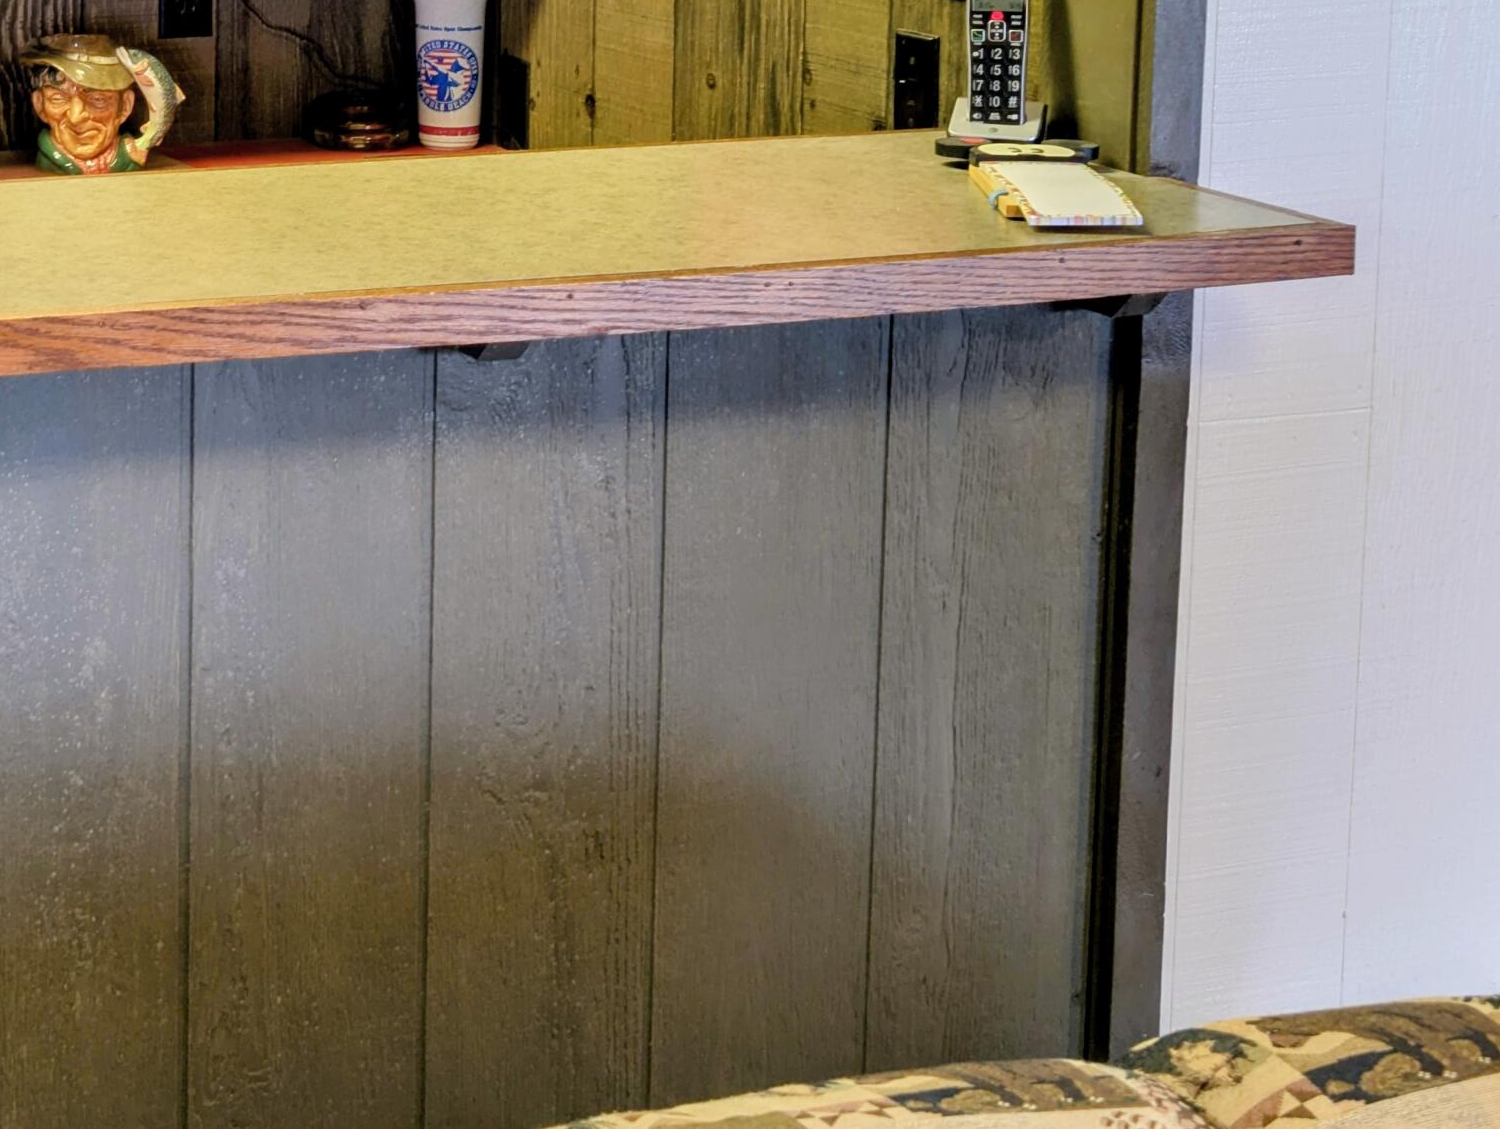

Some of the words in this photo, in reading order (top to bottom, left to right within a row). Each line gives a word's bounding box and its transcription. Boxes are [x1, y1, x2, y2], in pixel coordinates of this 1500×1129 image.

[994, 48, 1003, 60] 2
[1012, 48, 1020, 60] 3
[976, 64, 984, 76] 4
[993, 64, 1002, 76] 5
[1012, 64, 1020, 76] 6
[993, 80, 1001, 92] 8
[1012, 80, 1020, 92] 9
[992, 96, 1000, 108] 0
